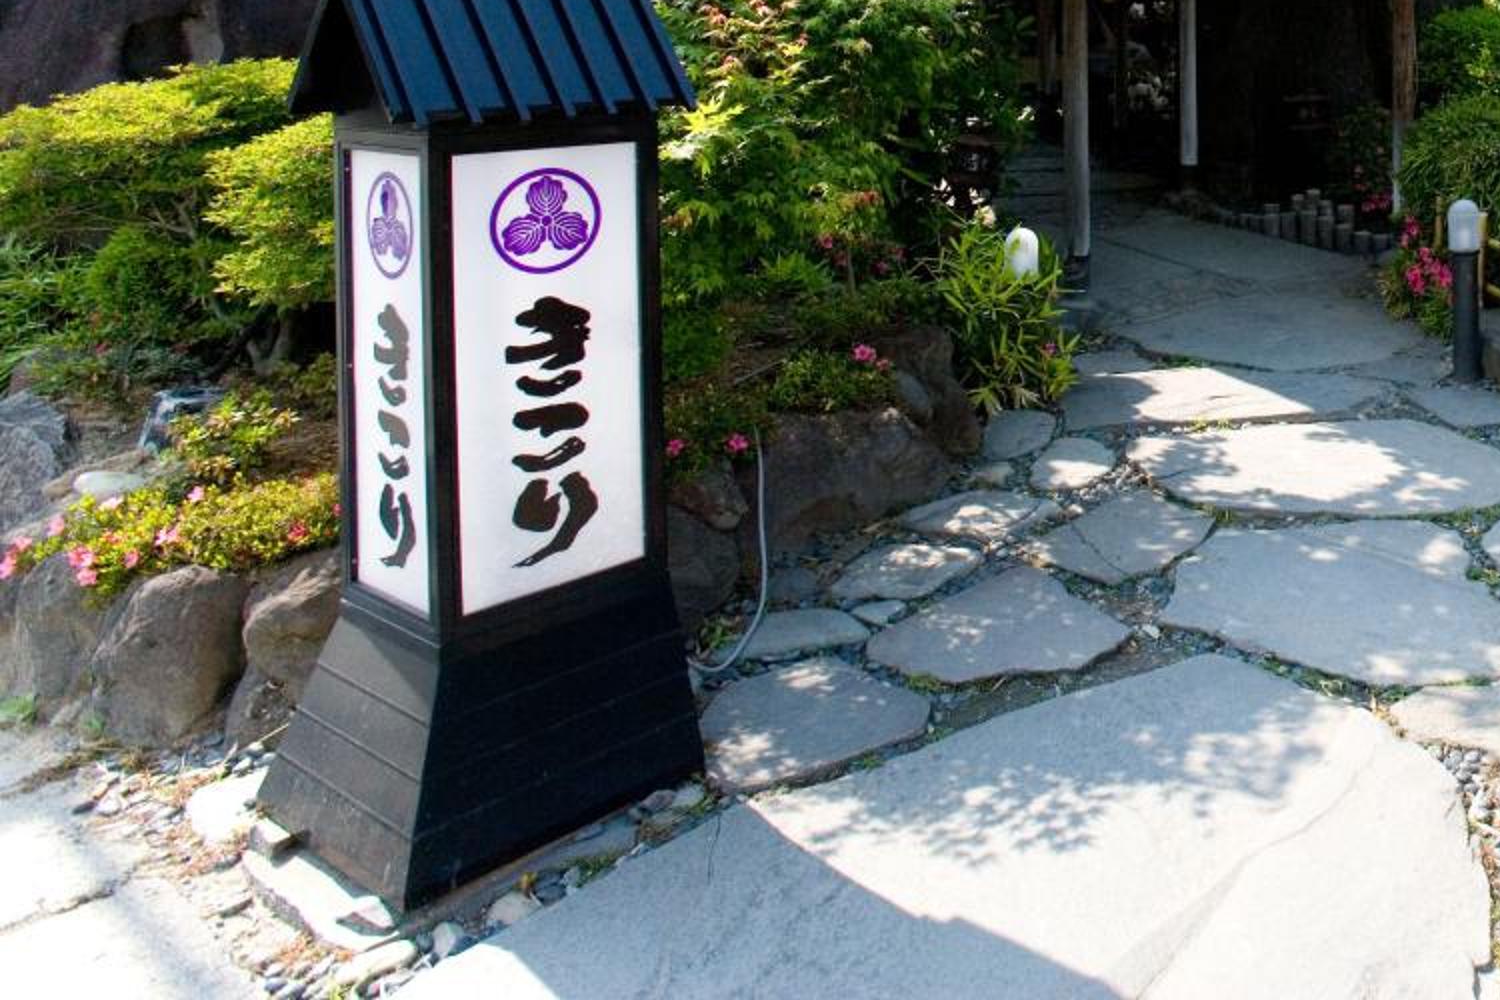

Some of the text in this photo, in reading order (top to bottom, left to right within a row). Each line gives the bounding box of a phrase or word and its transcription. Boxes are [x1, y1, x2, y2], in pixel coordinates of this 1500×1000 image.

[373, 303, 417, 569] きこり
[504, 295, 599, 569] きこり
